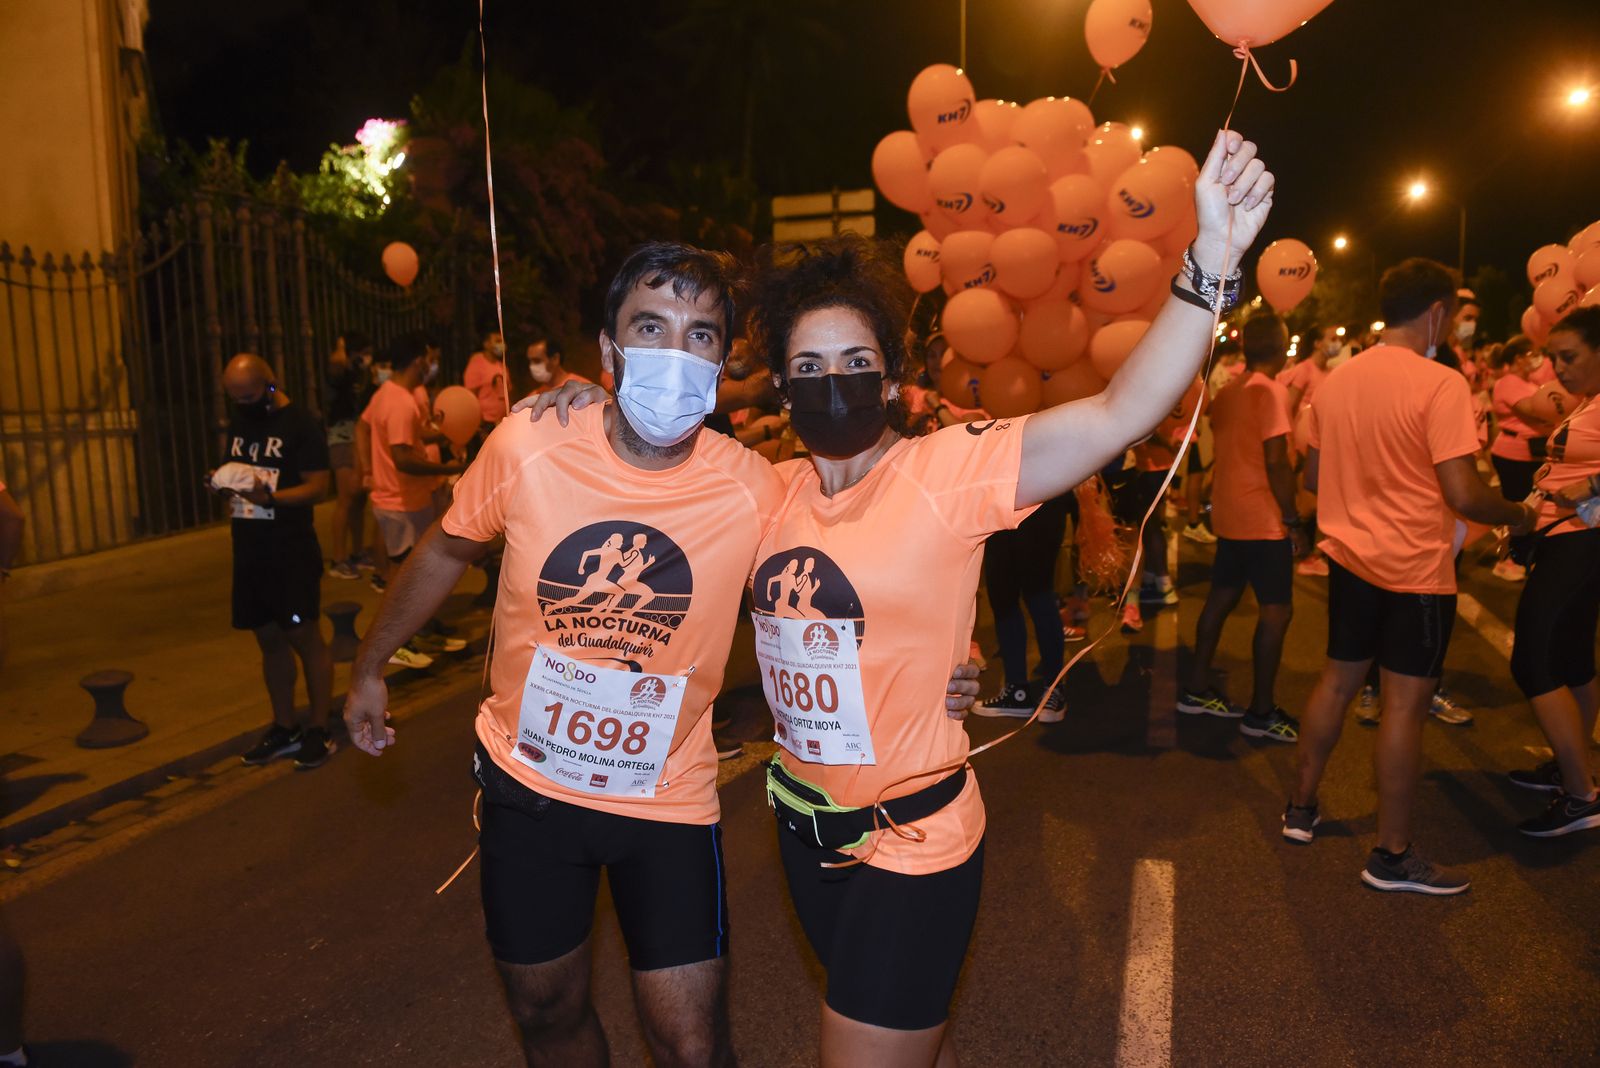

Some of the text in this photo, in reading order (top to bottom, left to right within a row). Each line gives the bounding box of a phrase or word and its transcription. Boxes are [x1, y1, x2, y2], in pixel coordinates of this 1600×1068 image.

[937, 104, 967, 124] KH7
[1057, 221, 1092, 237] KH7
[1279, 265, 1306, 278] KH7
[544, 616, 672, 646] LA NOCTURNA
[558, 632, 654, 658] del Guadalquivir
[769, 665, 839, 713] 1680
[546, 689, 570, 702] CARRERA
[571, 698, 601, 711] NOCTURNA
[613, 708, 652, 719] GUADALQUIVIR
[544, 701, 650, 755] 1698
[794, 716, 813, 730] ORTIZ
[815, 720, 841, 731] MOYA
[523, 728, 545, 745] JUAN
[545, 740, 577, 759] PEDRO
[578, 752, 615, 768] MOLINA
[617, 760, 656, 771] ORTEGA
